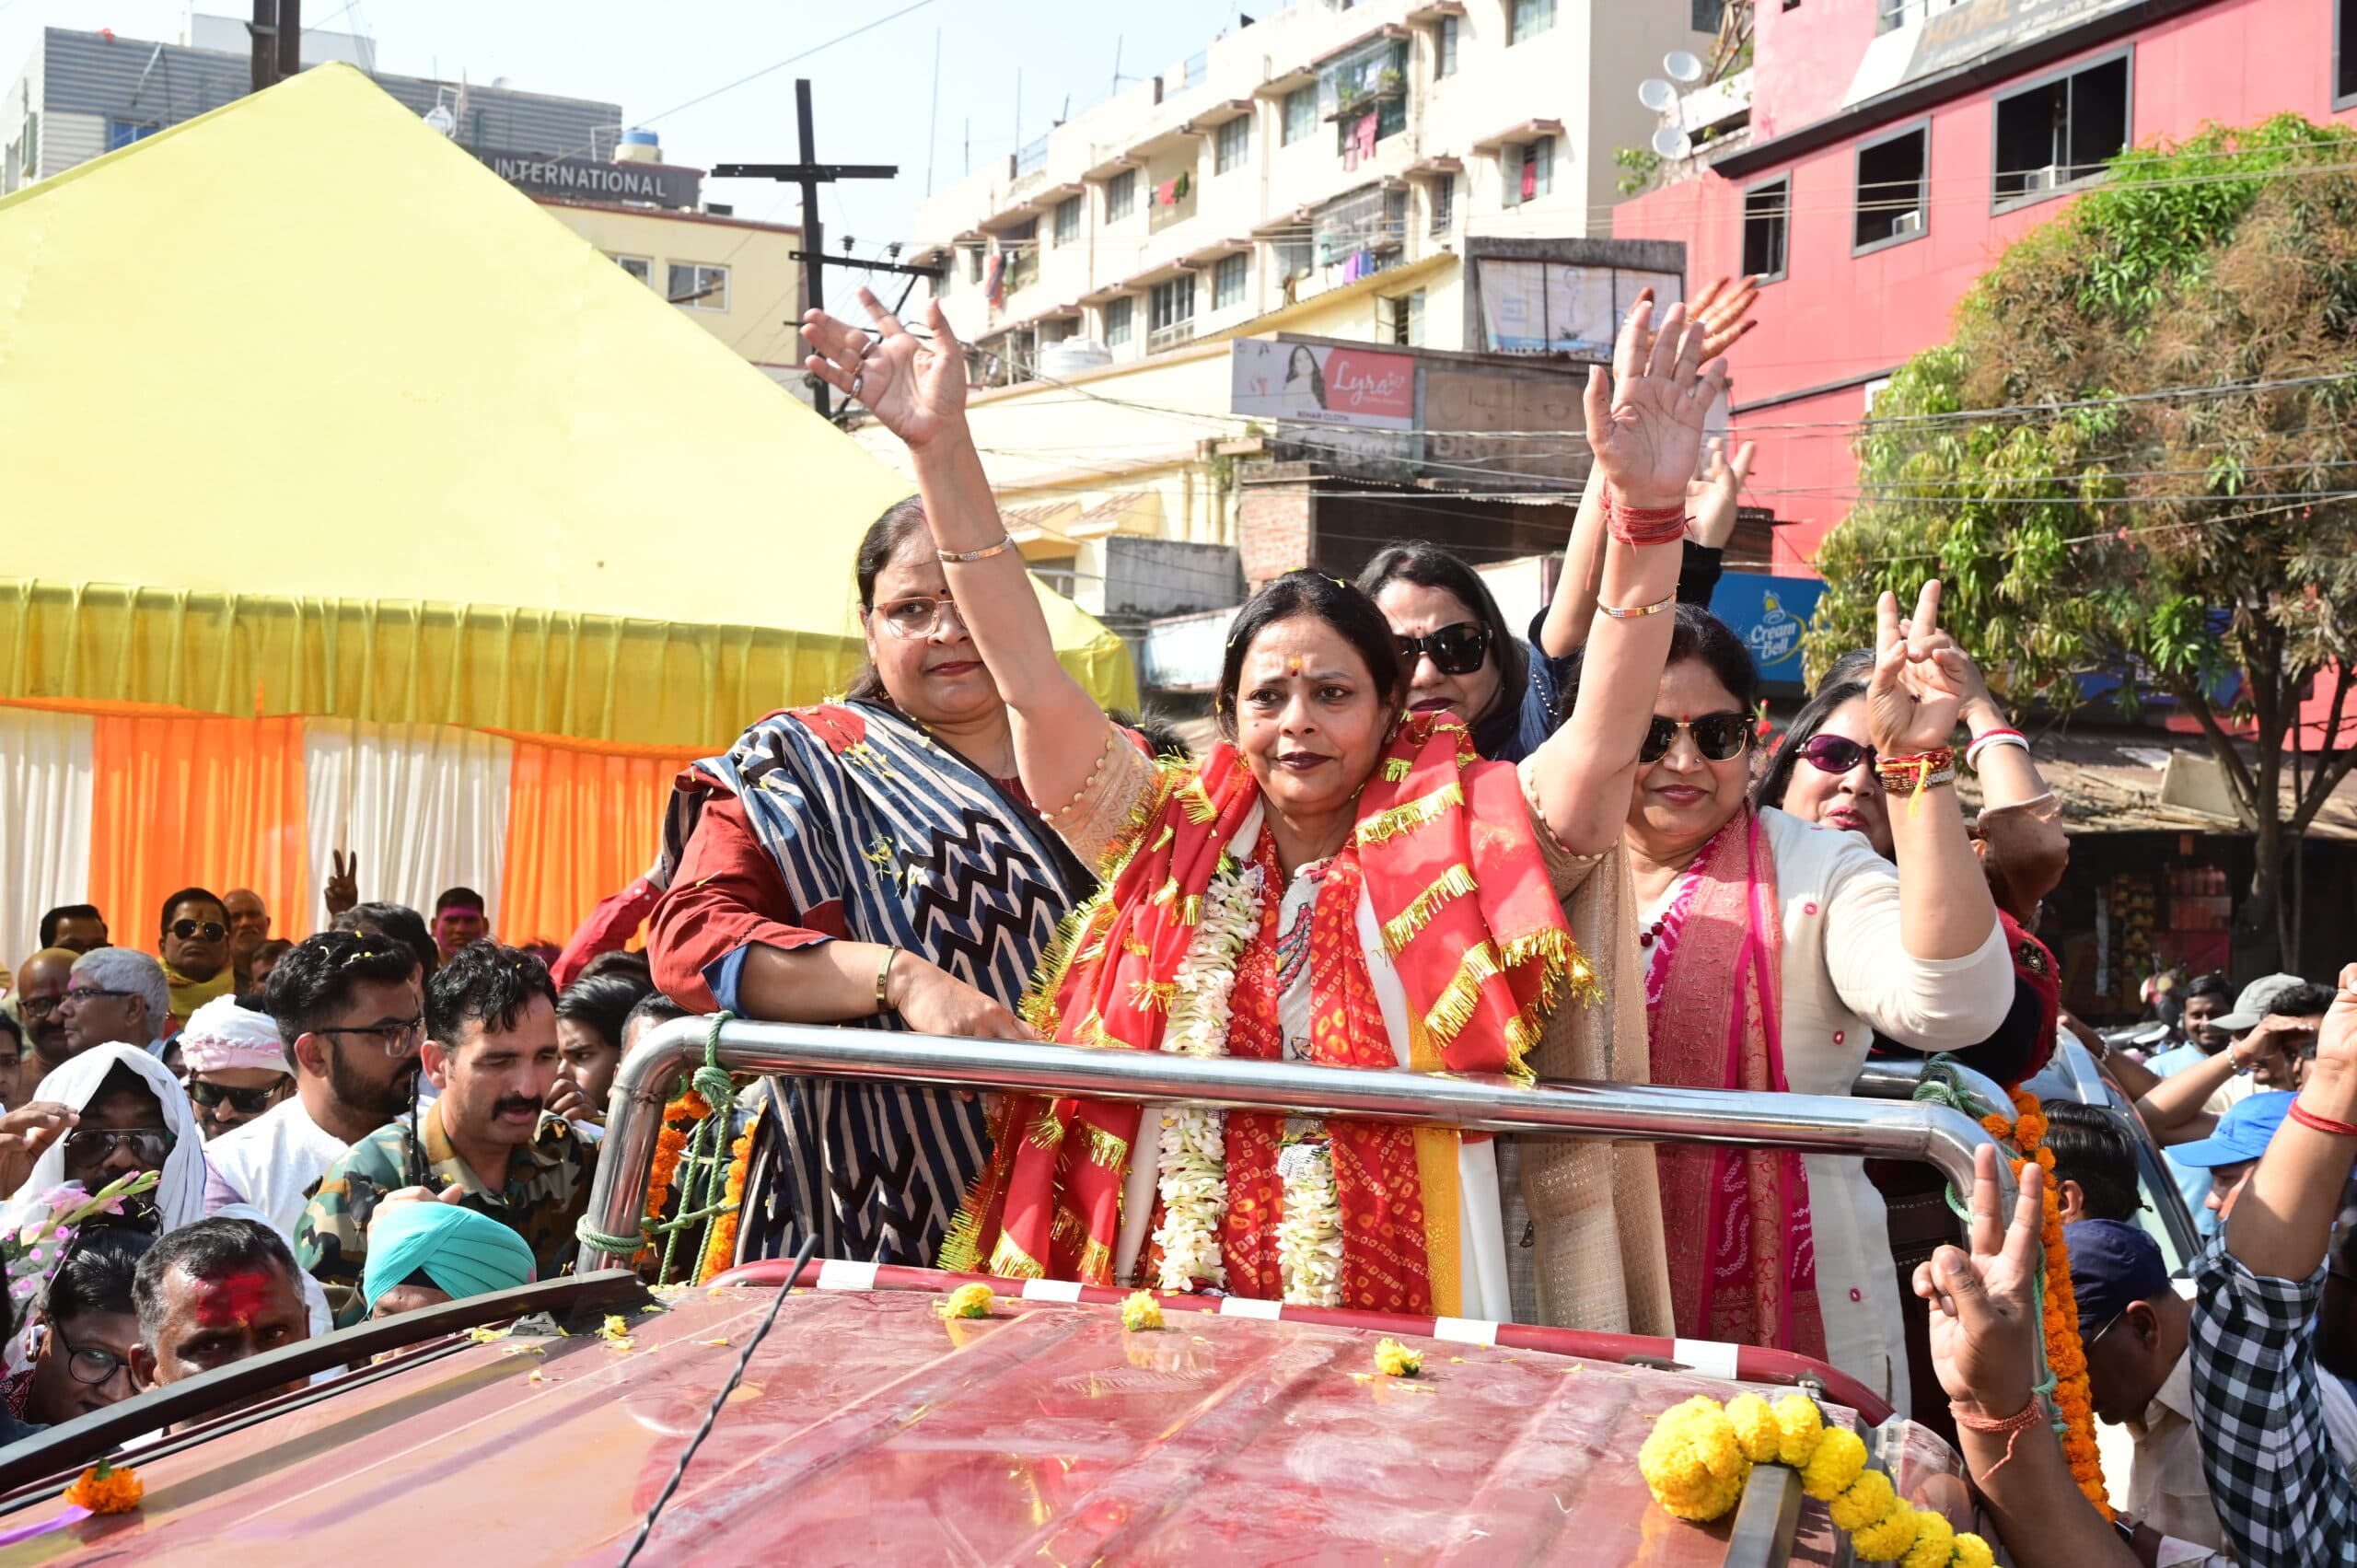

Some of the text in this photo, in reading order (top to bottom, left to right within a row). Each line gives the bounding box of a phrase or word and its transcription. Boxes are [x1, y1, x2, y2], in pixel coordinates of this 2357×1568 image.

[1922, 0, 2011, 51] HOTEL
[494, 157, 668, 197] INTERNATIONAL
[1332, 360, 1393, 406] Lyra
[1750, 622, 1796, 643] Cream
[1760, 637, 1789, 659] Bell
